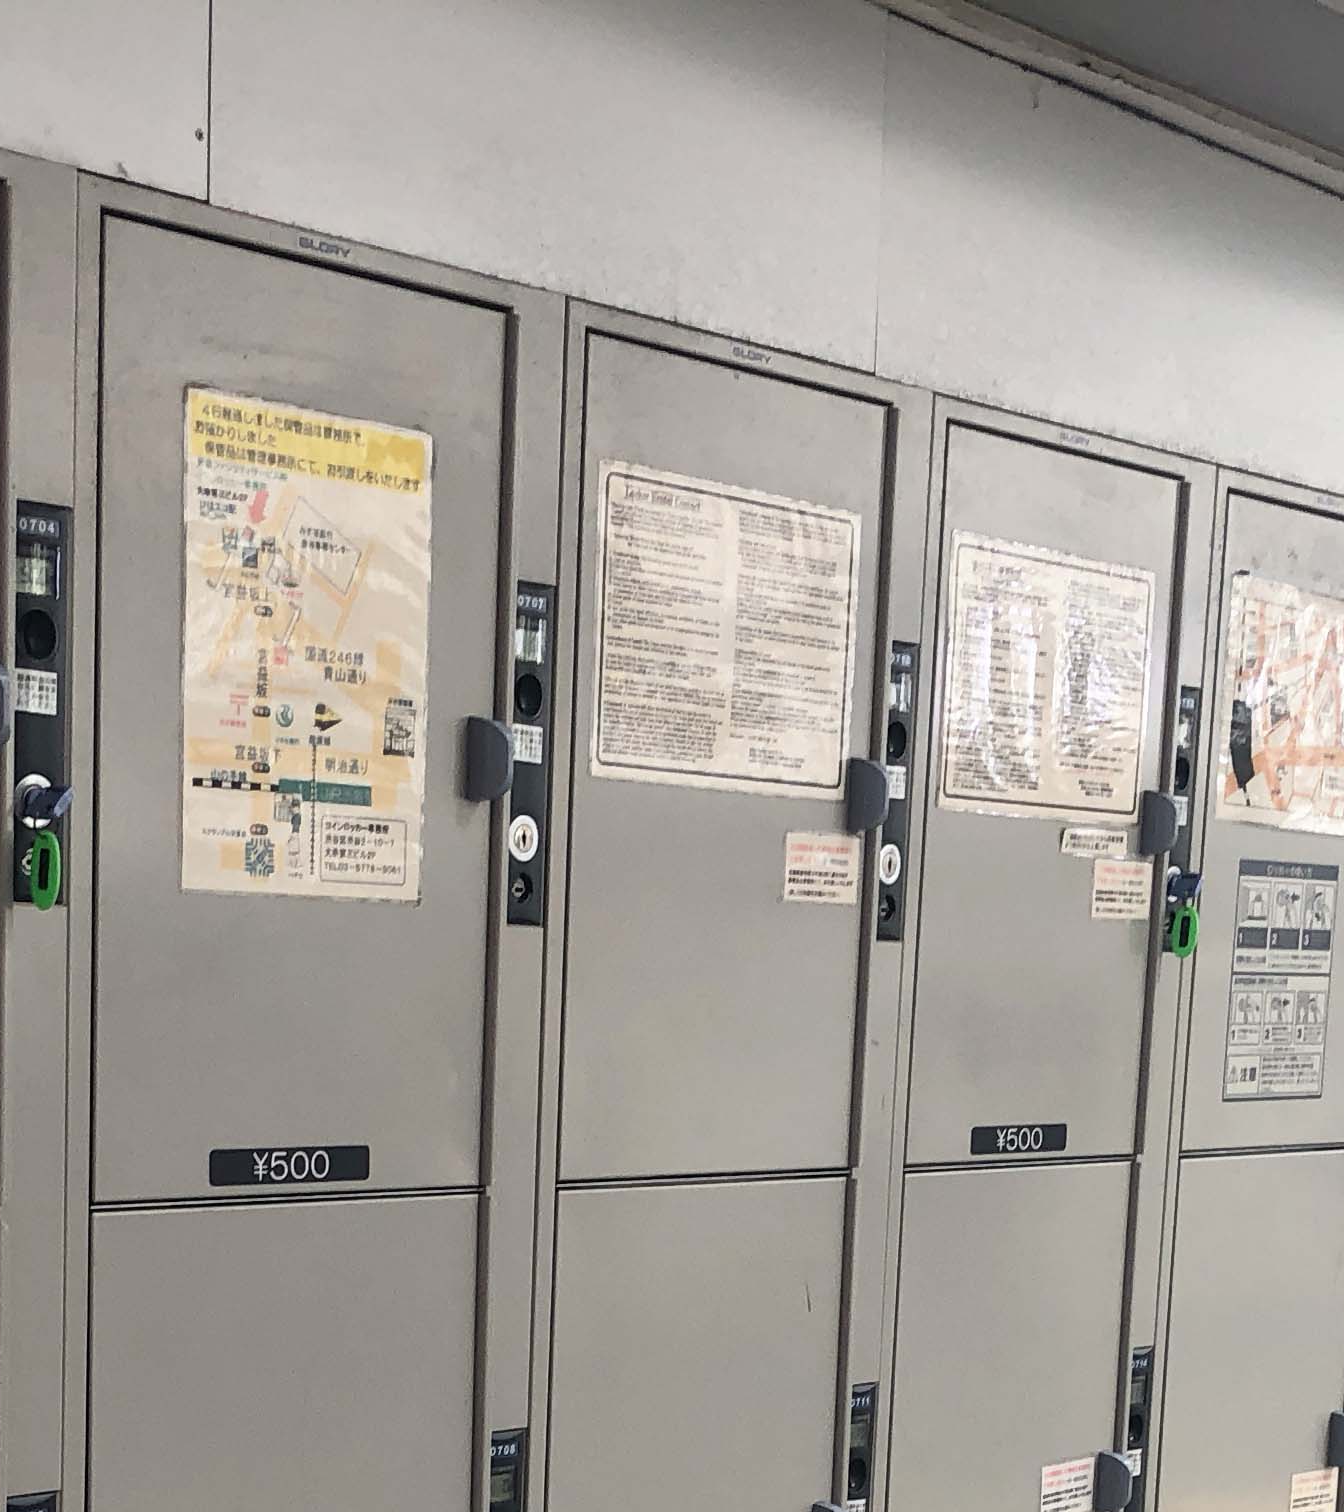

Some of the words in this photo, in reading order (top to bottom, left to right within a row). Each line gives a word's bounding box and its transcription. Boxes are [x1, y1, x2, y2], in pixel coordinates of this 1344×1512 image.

[299, 236, 350, 257] GLORY
[18, 517, 56, 534] 0704
[997, 1128, 1043, 1152] ¥500
[253, 1150, 330, 1181] ¥500
